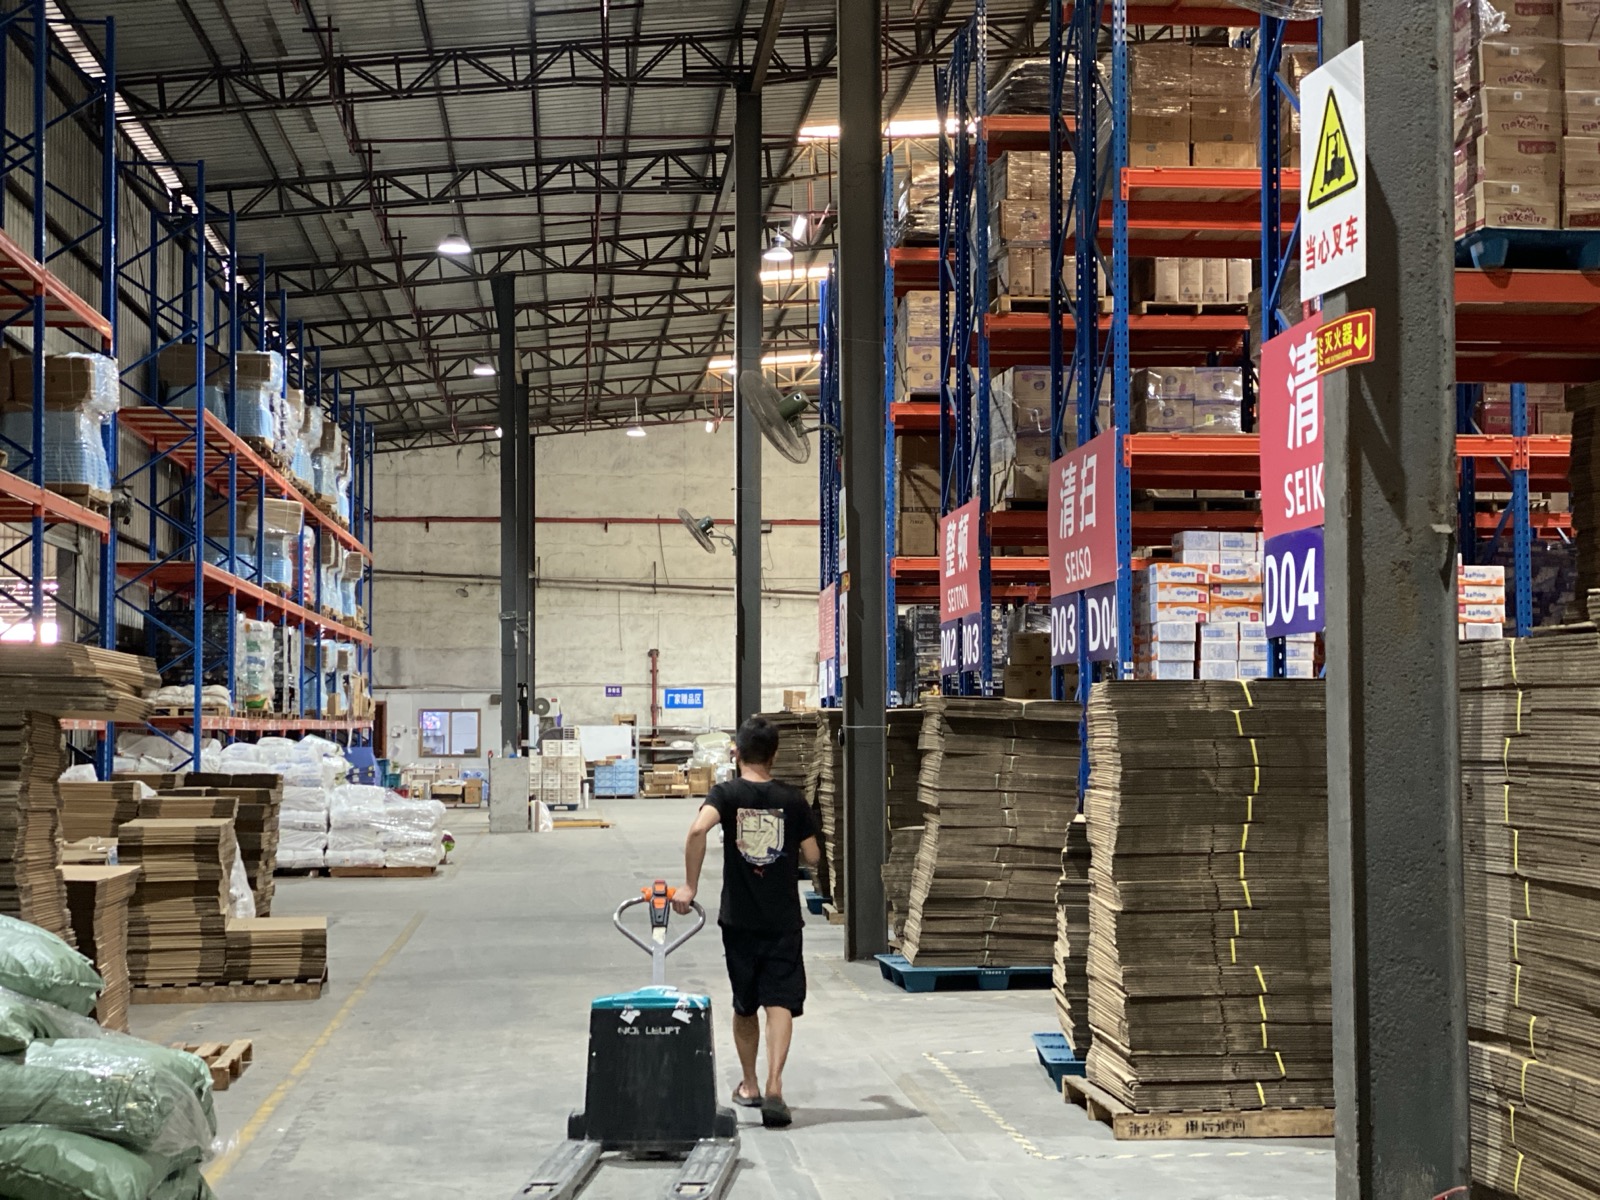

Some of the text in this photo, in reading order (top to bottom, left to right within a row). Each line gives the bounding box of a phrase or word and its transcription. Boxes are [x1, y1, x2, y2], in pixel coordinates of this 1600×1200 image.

[1305, 214, 1359, 271] 当心叉车
[1324, 321, 1353, 354] 灭火器
[1287, 331, 1319, 450] 清
[1059, 453, 1098, 539] 清扫
[1284, 462, 1325, 519] SEIK
[945, 513, 970, 578] 整顿
[1065, 545, 1092, 585] SEISO
[947, 583, 970, 613] SEITON
[1265, 548, 1320, 627] D04
[940, 627, 957, 669] D02
[1051, 603, 1076, 657] D03
[1087, 594, 1117, 652] D04
